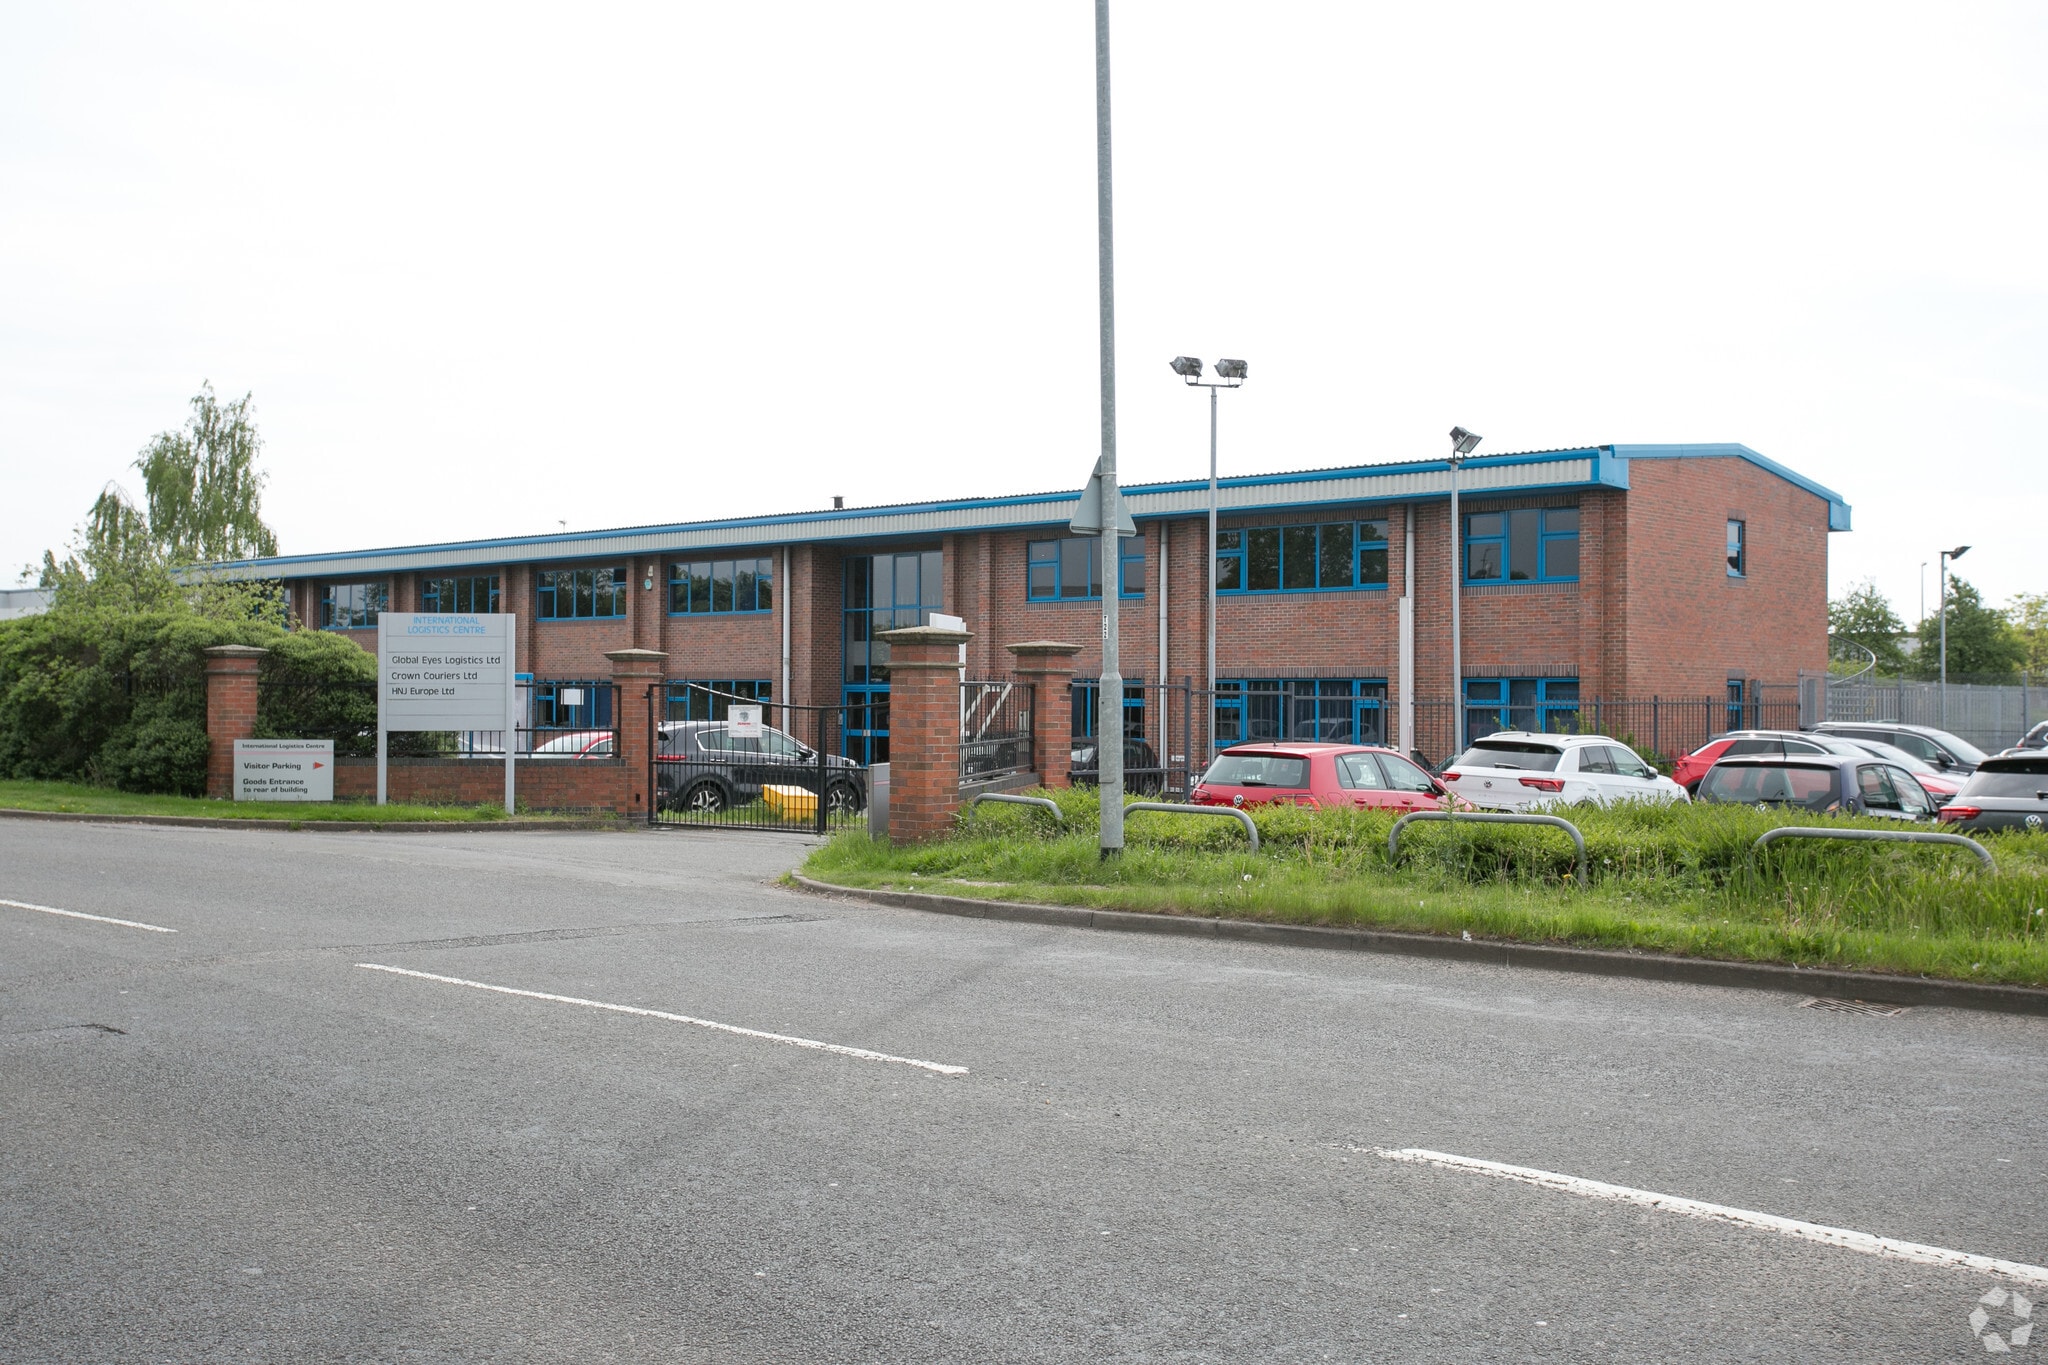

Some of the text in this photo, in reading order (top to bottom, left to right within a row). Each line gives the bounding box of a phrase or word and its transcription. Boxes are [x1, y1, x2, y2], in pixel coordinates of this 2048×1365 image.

[413, 616, 480, 625] INTERNATIONAL
[407, 625, 486, 634] LOGISTICS CENTRE
[391, 655, 501, 665] Global Eyes Logistics Ltd
[391, 672, 478, 680] Crown Couriers Ltd
[391, 687, 455, 696] HNJ Europe Ltd
[272, 762, 302, 770] Parking
